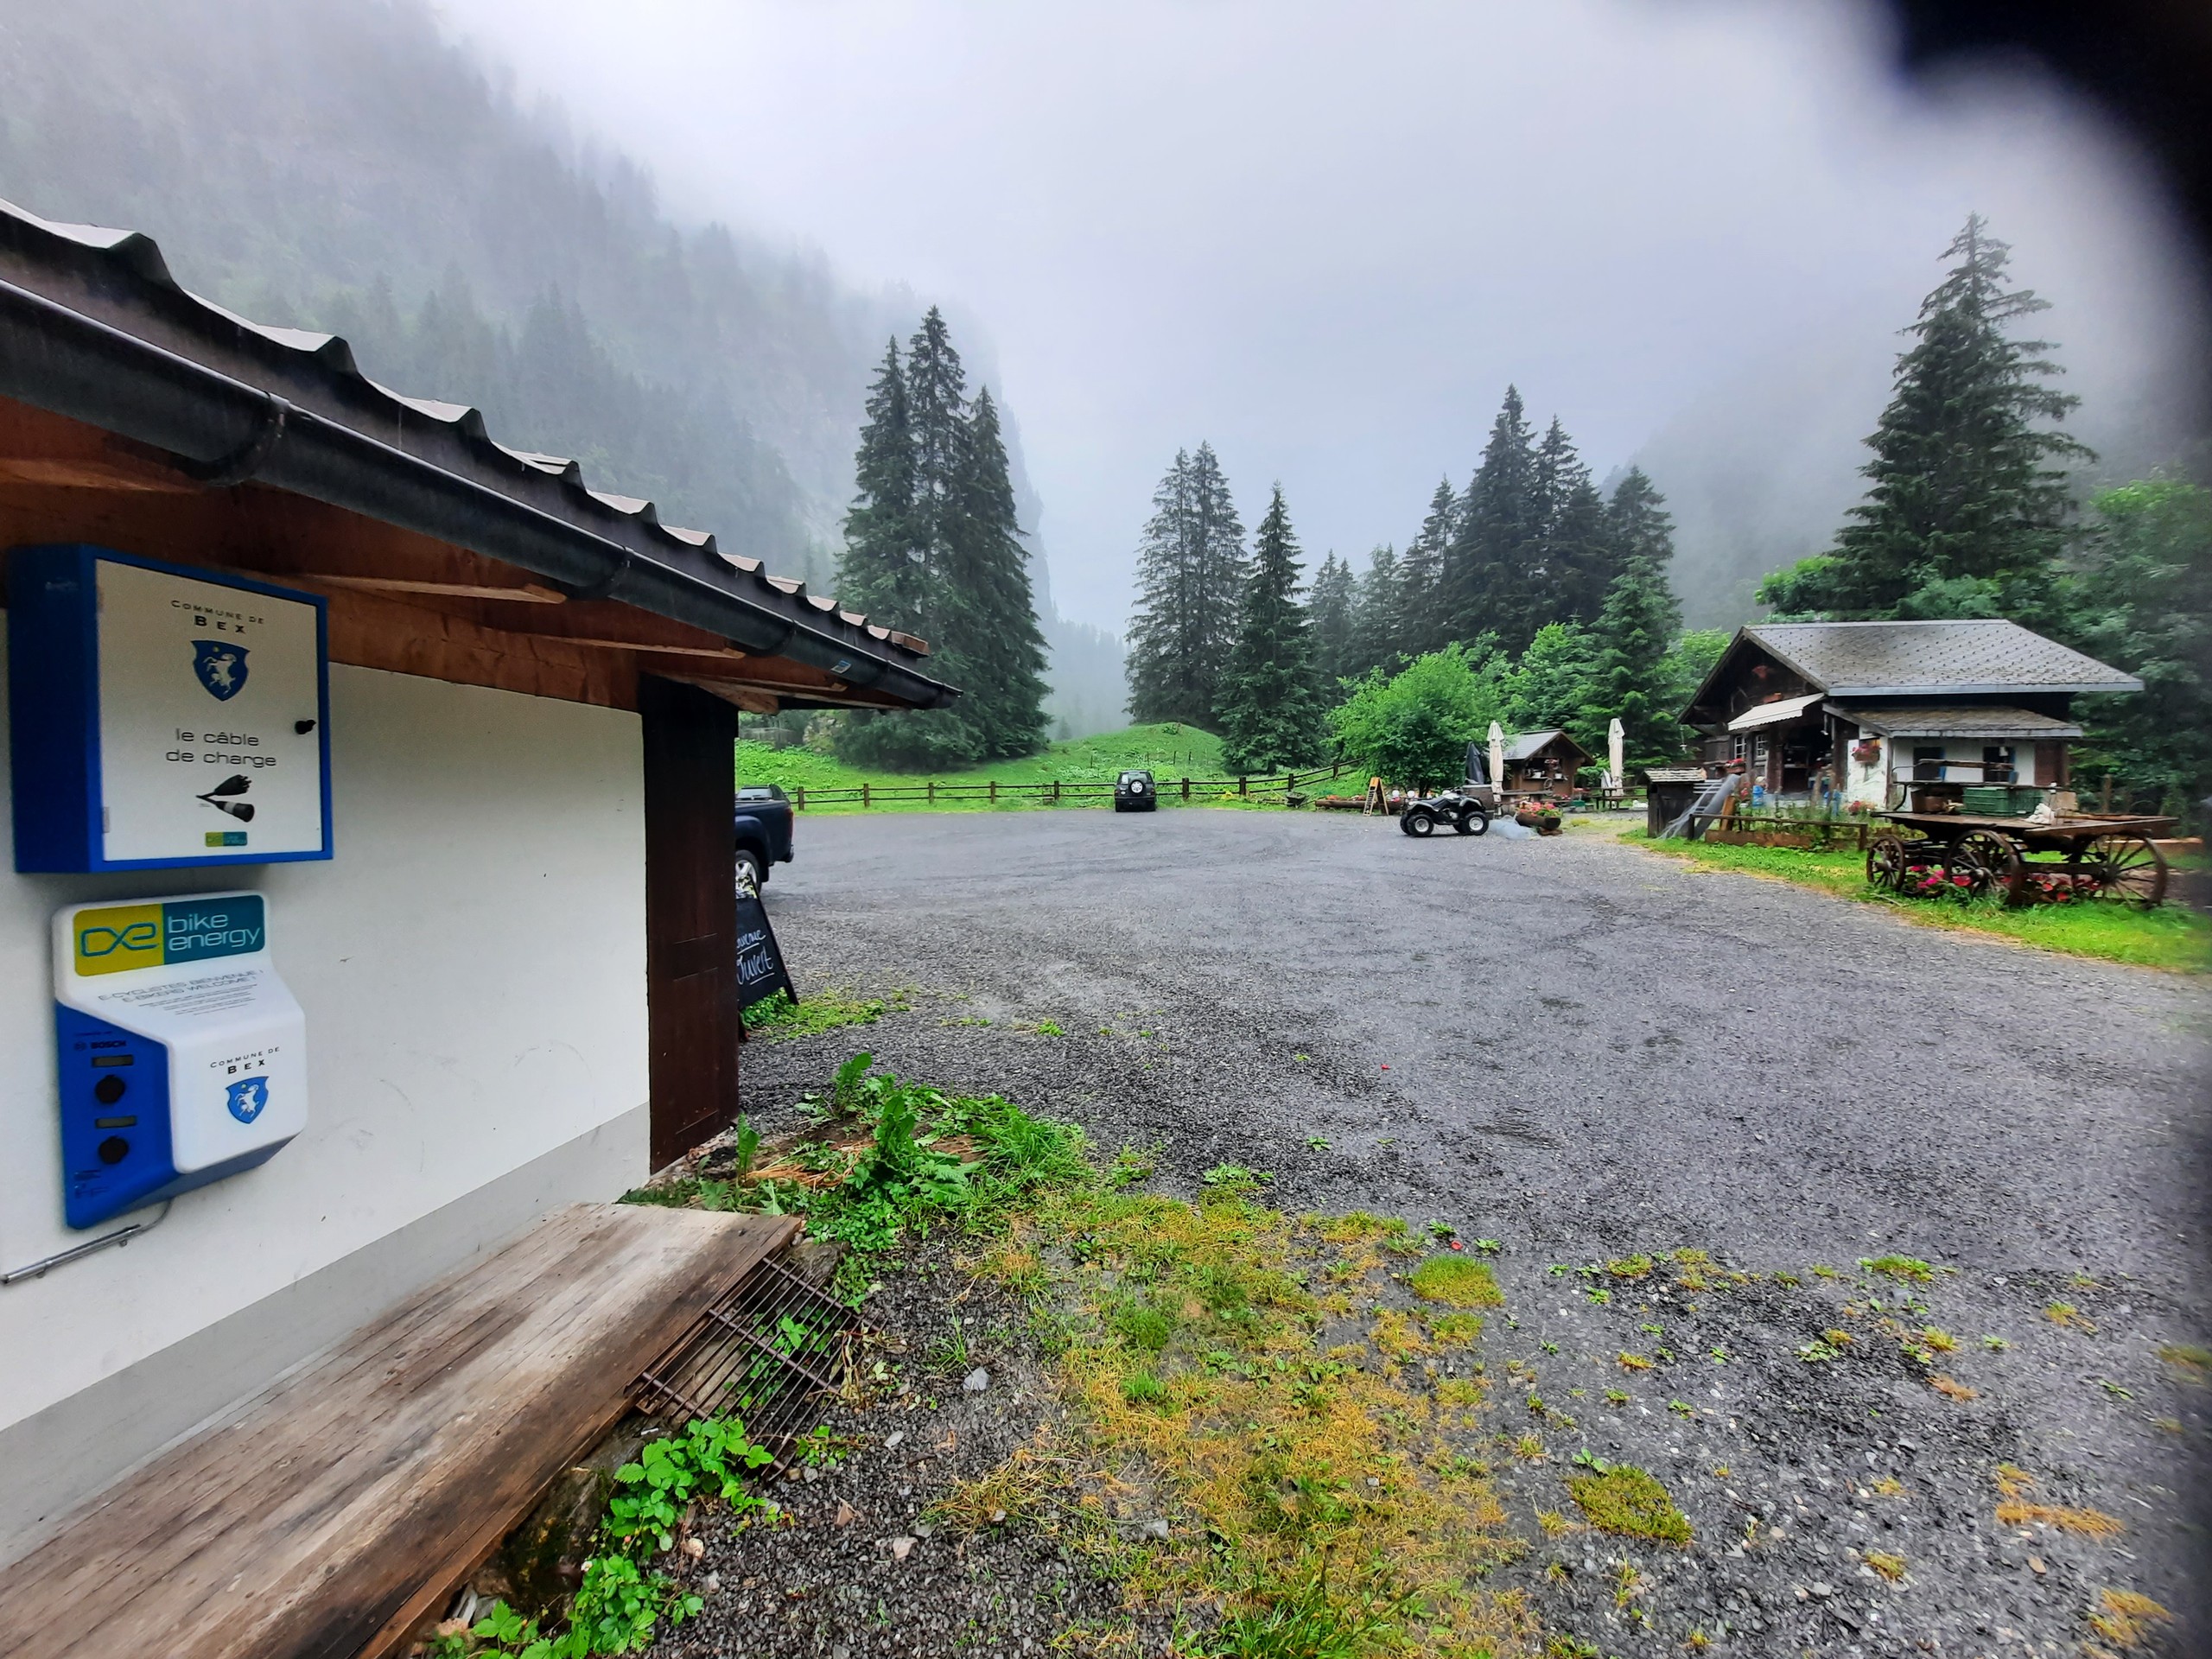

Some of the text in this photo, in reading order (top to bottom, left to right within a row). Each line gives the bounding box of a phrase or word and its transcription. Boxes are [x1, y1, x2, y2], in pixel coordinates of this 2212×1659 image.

[171, 600, 264, 625] COMMUNE DE
[194, 614, 246, 634] BEX
[175, 728, 259, 747] le câble
[166, 749, 276, 768] de charge
[168, 912, 228, 934] bike
[168, 927, 261, 951] energy
[209, 1046, 281, 1069] COMMUNE DE
[227, 1058, 265, 1075] BEX
